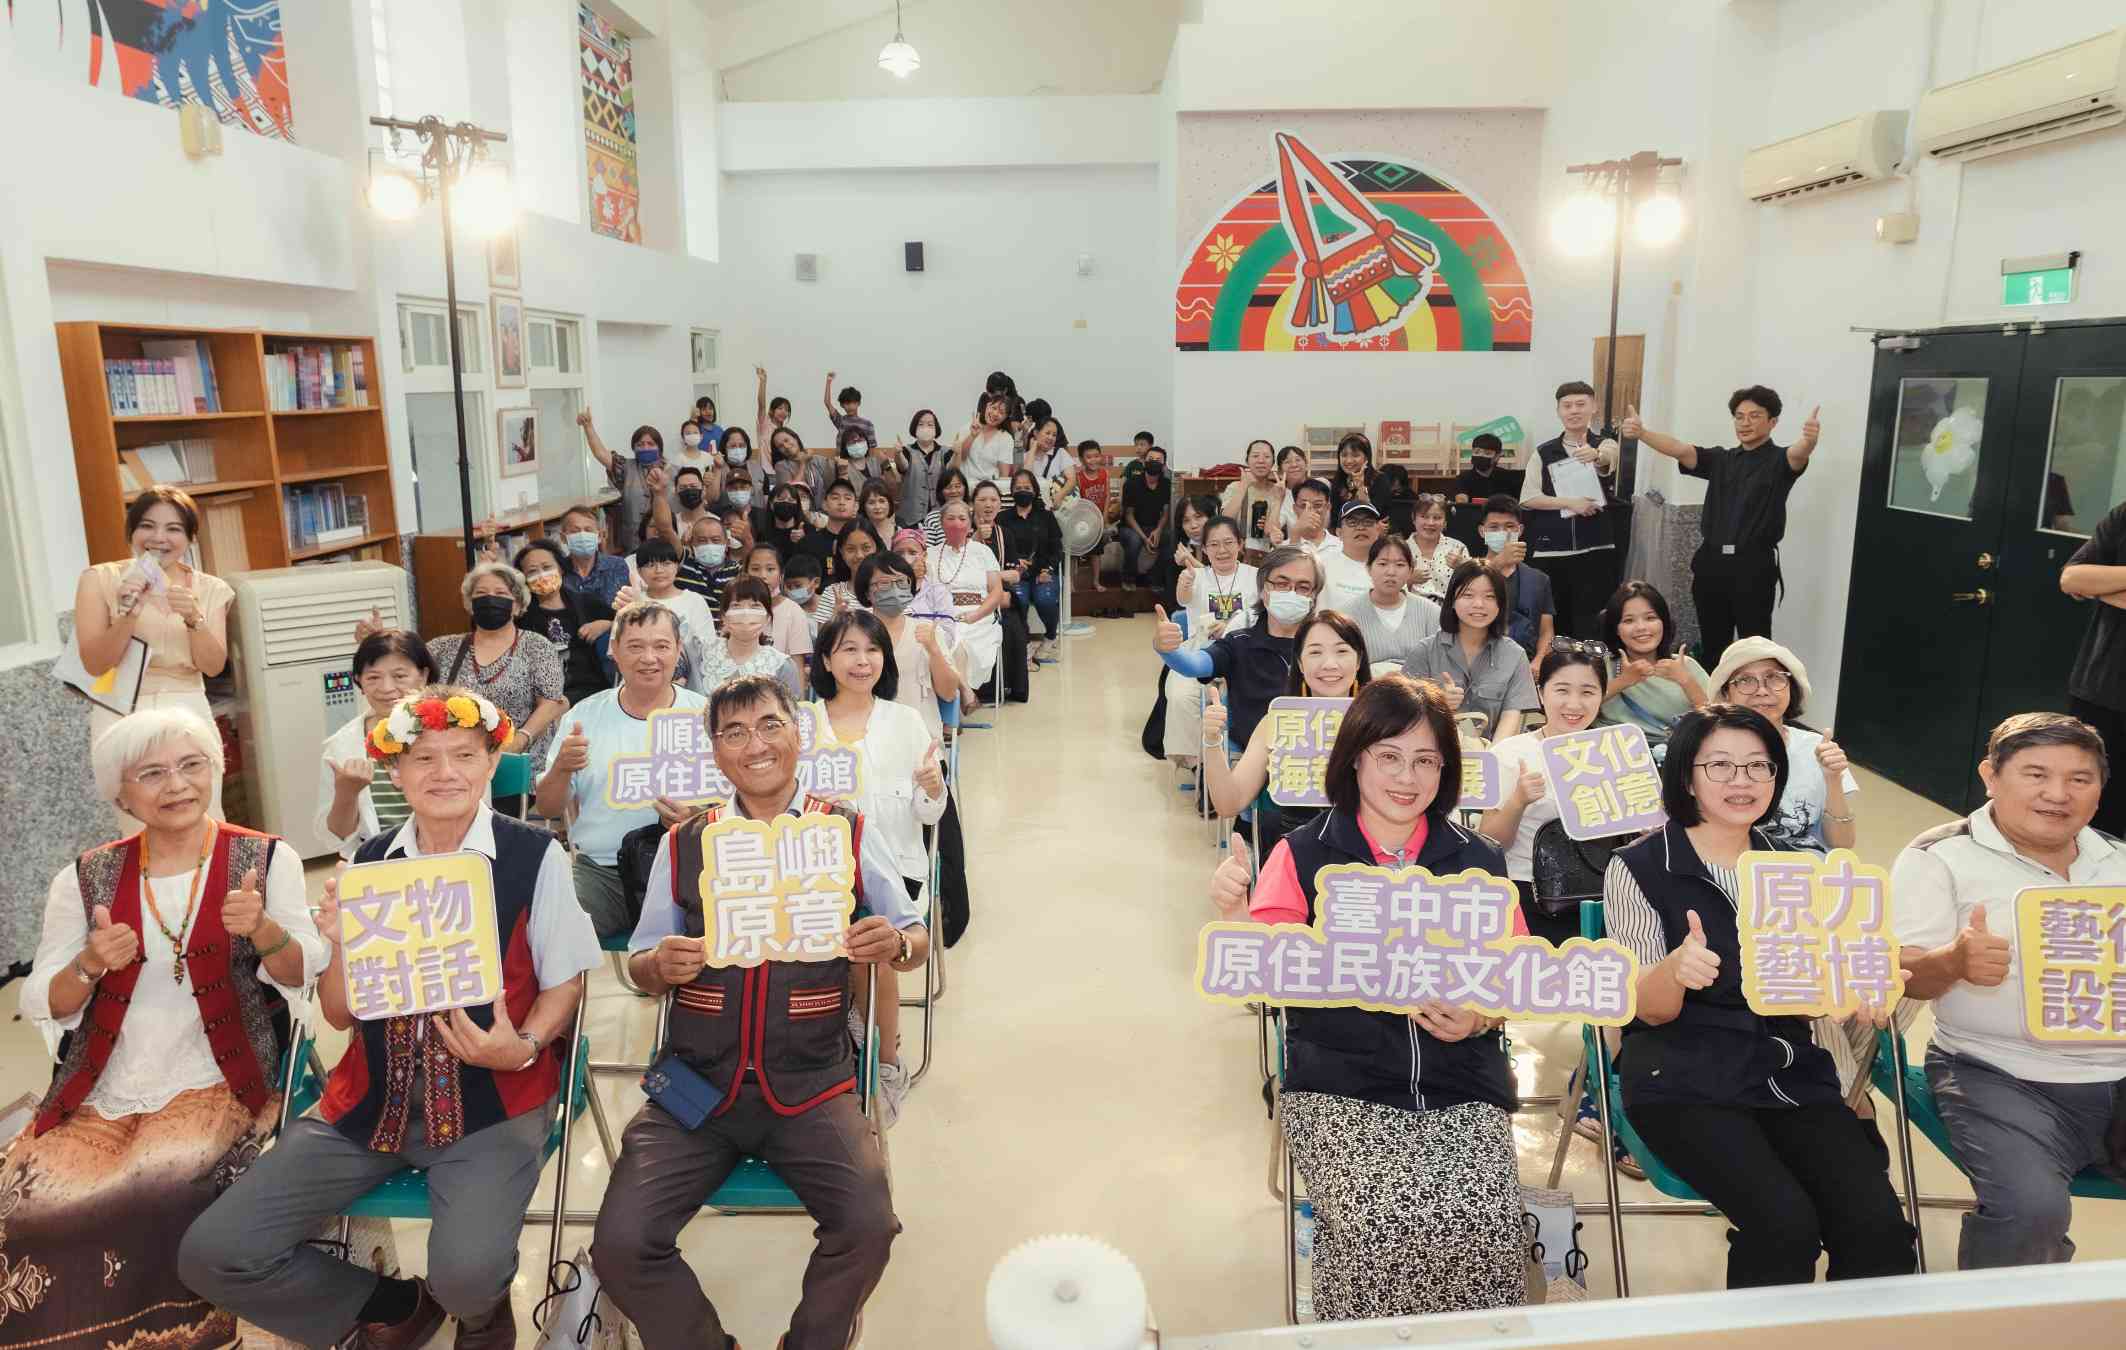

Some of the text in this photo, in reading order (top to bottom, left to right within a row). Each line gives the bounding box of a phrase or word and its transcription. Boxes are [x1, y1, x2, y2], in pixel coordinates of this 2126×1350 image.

[1552, 729, 1650, 782] 文化
[1570, 772, 1664, 827] 創意
[711, 825, 848, 896] 島嶼
[341, 877, 474, 949] 文物
[714, 891, 850, 962] 原意
[1329, 879, 1504, 940] 臺中市
[1751, 863, 1885, 931] 原力
[2040, 899, 2126, 964] 藝
[348, 945, 483, 1016] 對話
[1208, 937, 1624, 1011] 原住民族文化館
[1754, 933, 1894, 1009] 藝博
[2038, 968, 2126, 1032] 設
